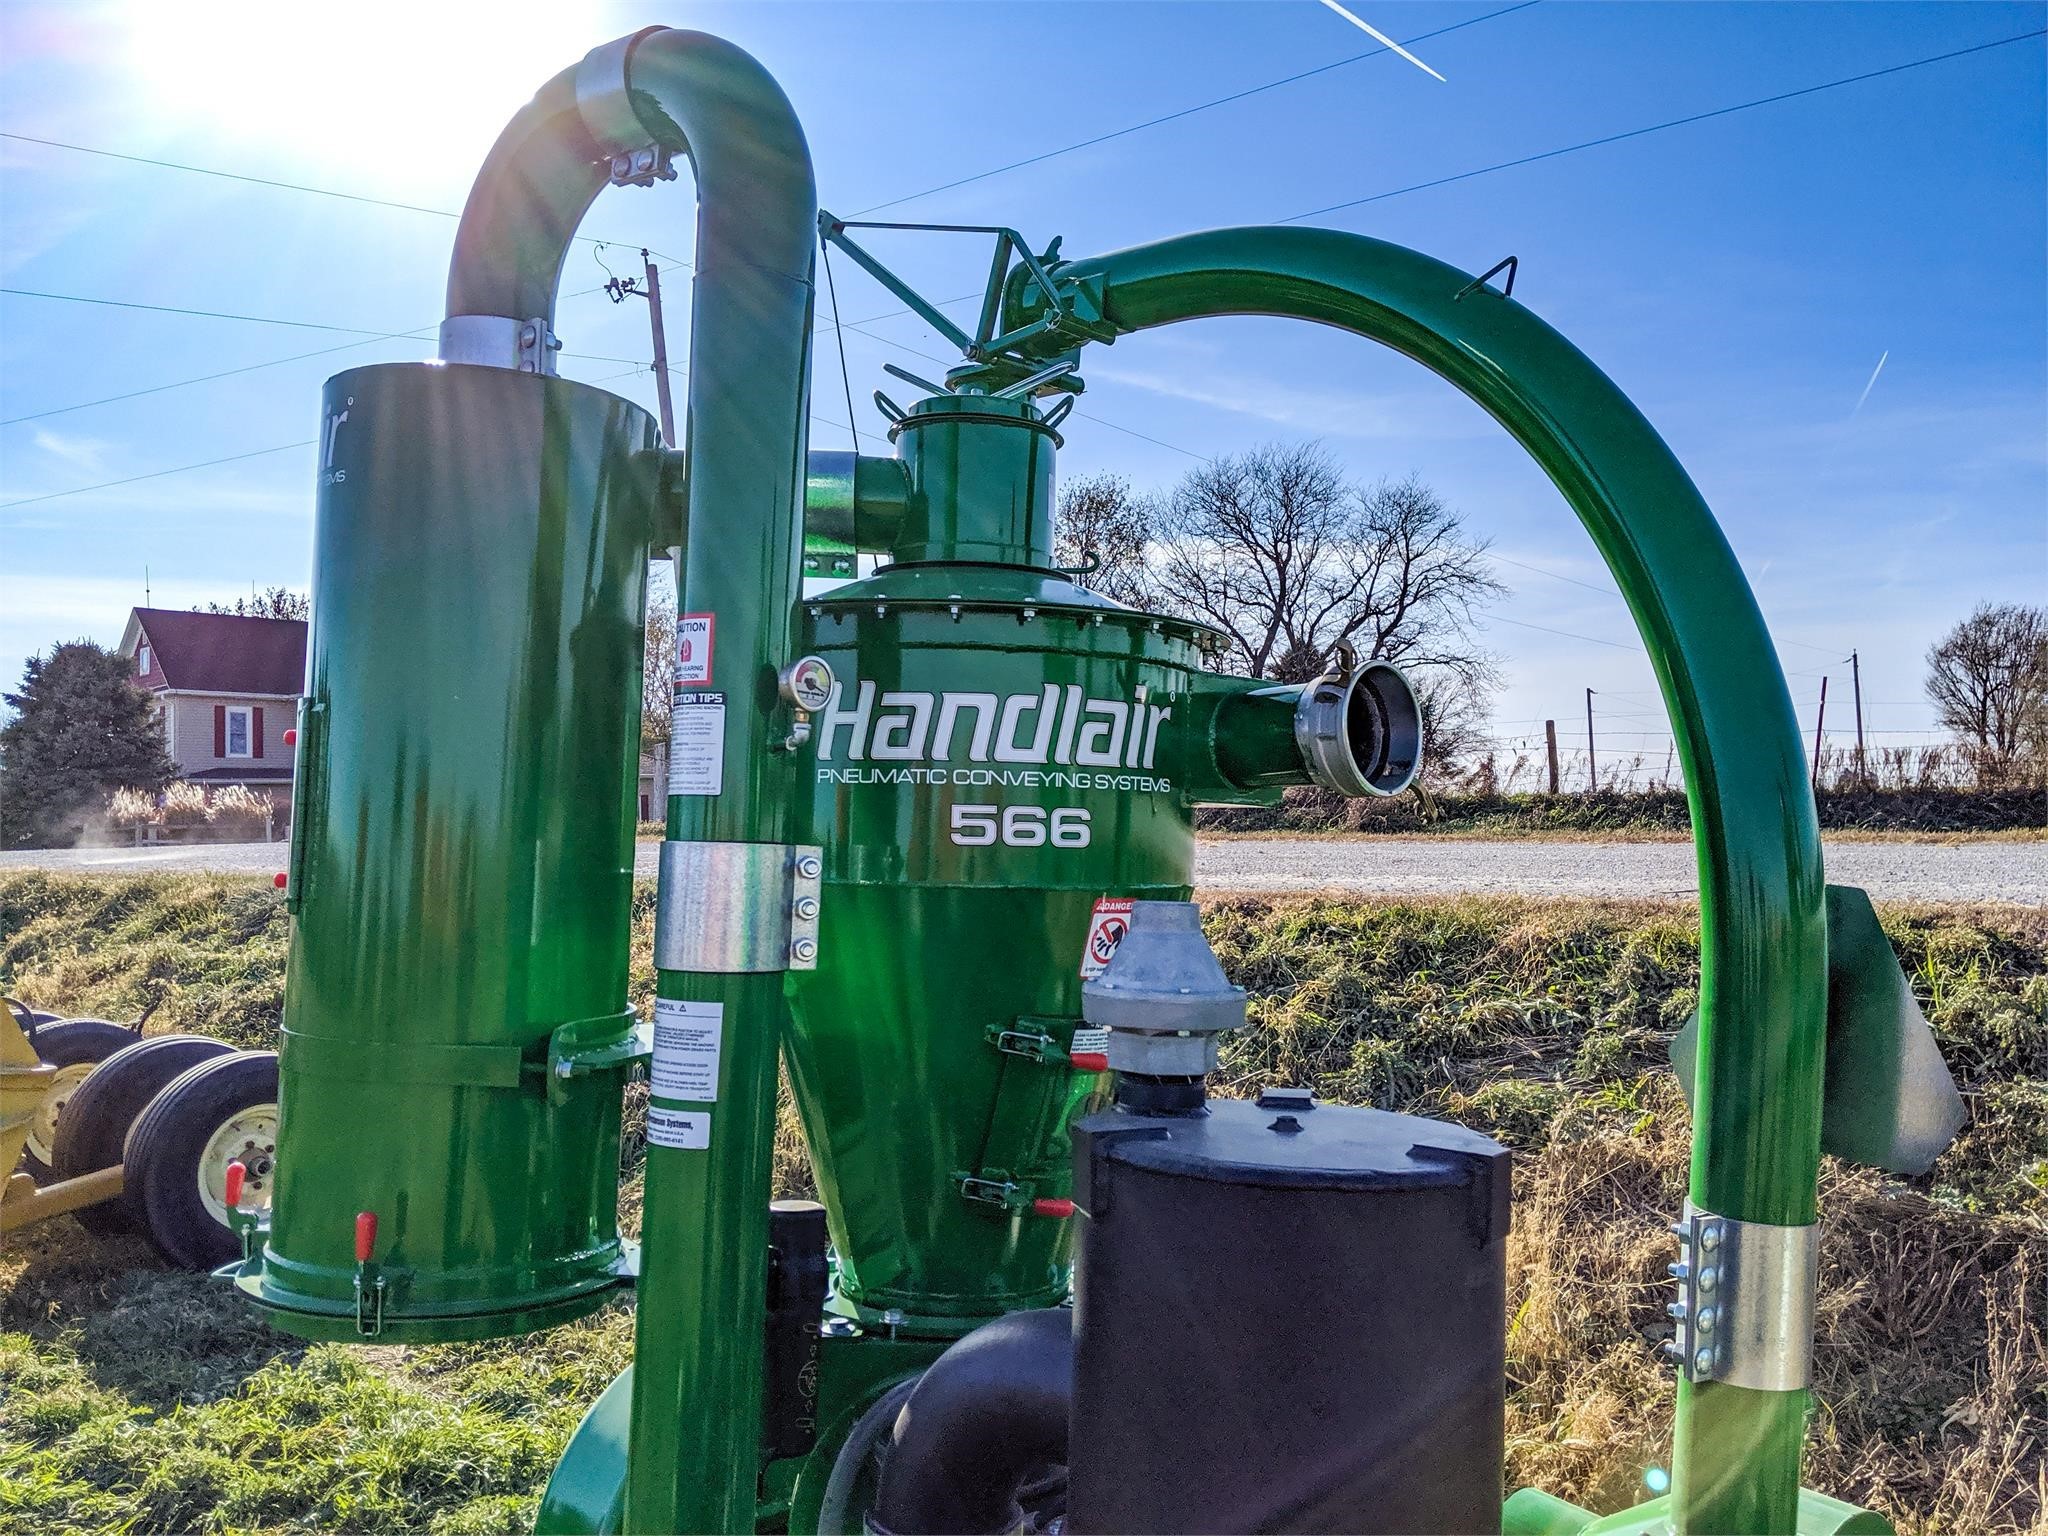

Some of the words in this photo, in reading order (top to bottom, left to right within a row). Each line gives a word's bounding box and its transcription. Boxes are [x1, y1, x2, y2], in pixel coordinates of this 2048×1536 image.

[677, 622, 707, 634] AUTION
[698, 693, 723, 703] TIPS
[816, 680, 1172, 770] Handlair
[817, 768, 947, 784] PNEUMATIC
[953, 770, 1091, 788] CONVEYING
[1094, 774, 1171, 793] SYSTEMS
[950, 803, 1092, 849] 566
[1105, 902, 1133, 911] DANGE
[666, 1118, 694, 1131] Systems,
